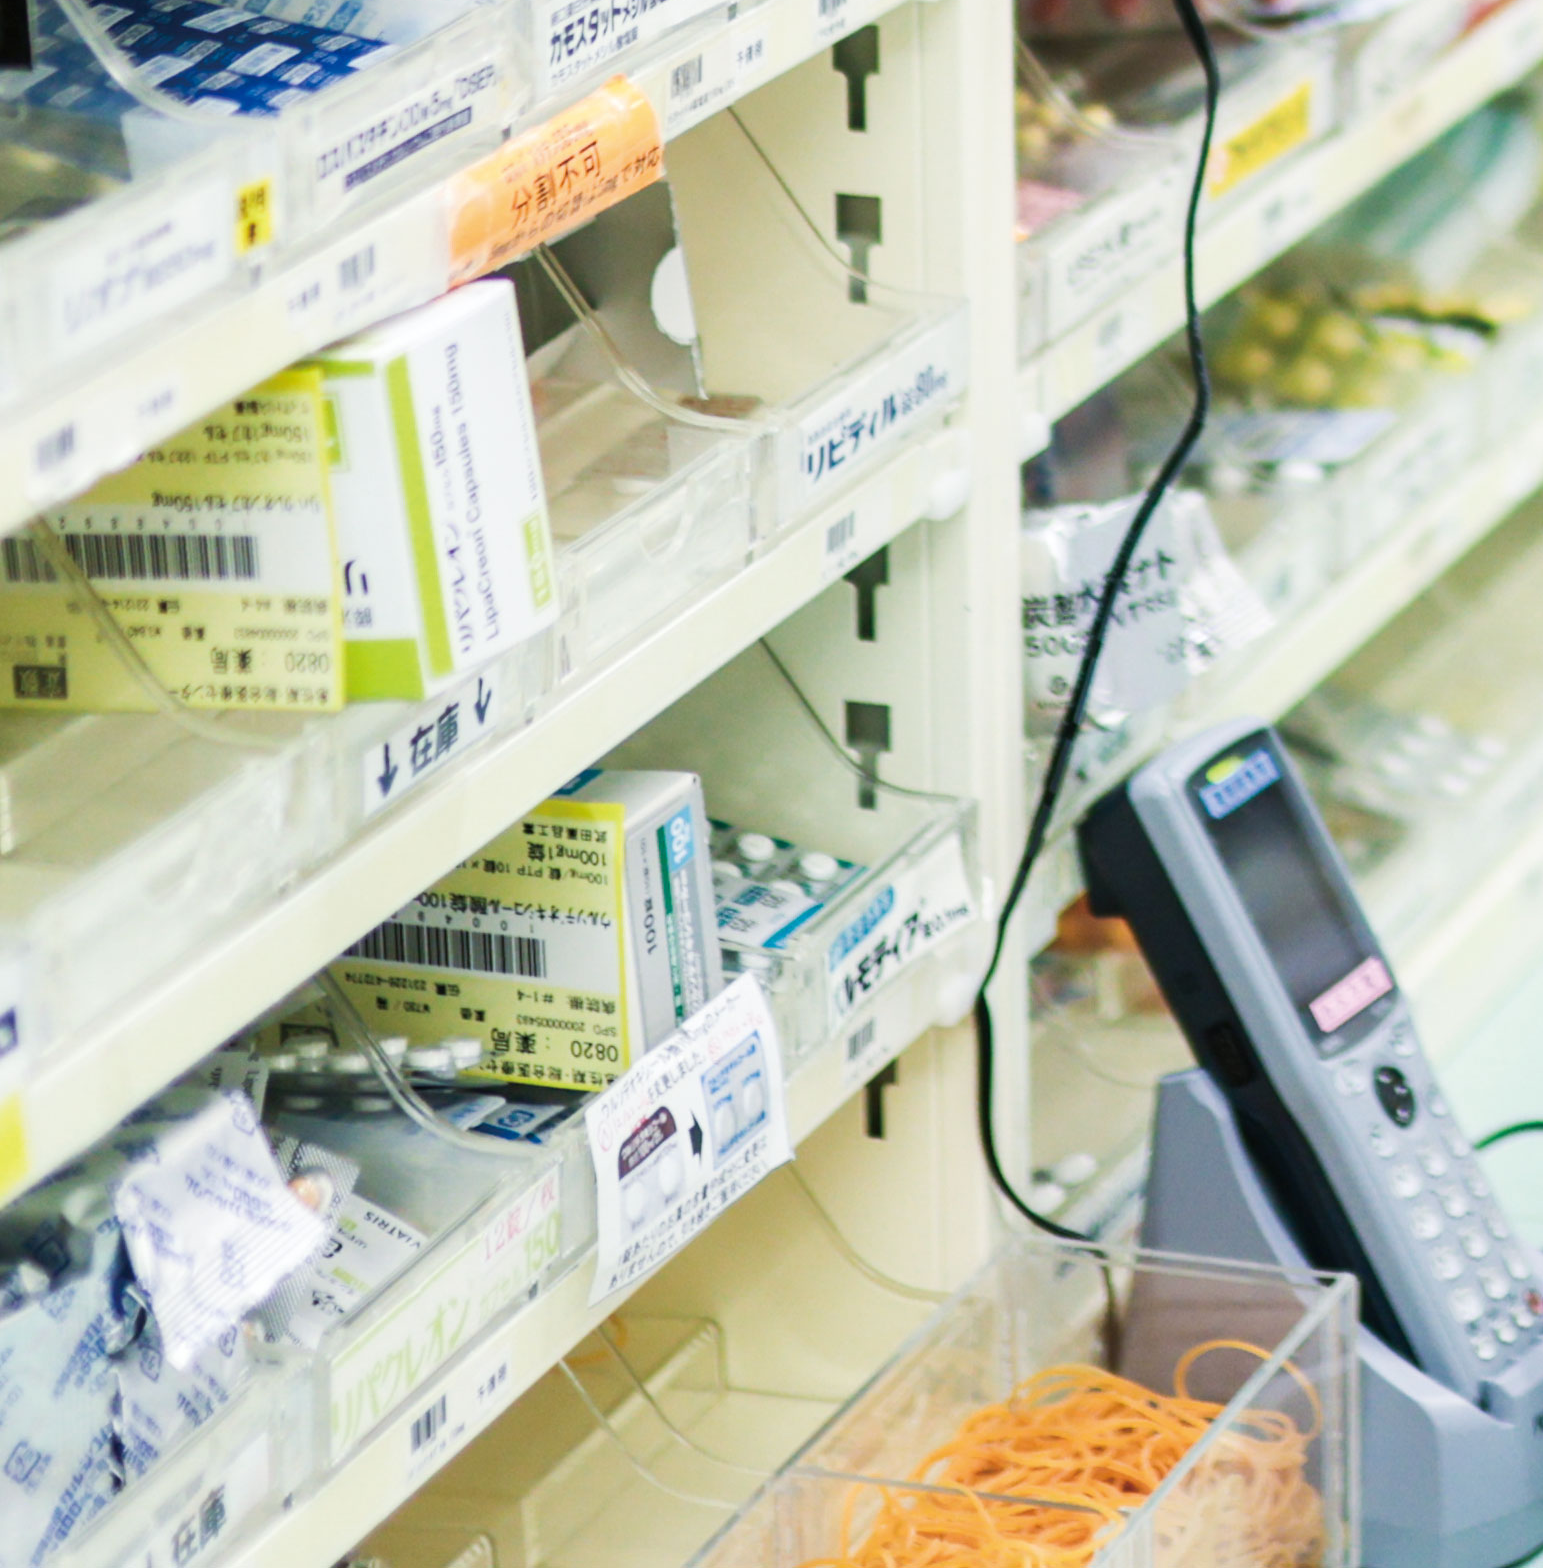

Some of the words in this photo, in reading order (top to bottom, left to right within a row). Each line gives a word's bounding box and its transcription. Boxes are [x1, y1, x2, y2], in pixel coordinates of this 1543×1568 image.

[510, 139, 602, 231] 分割不可
[442, 341, 467, 417] 150mg
[209, 647, 253, 674] 薬局
[284, 651, 330, 675] 0820
[408, 702, 464, 774] 在庫
[521, 820, 608, 844] 武田薬品工業
[525, 841, 609, 868] 100mg1錠
[515, 864, 544, 881] PTP
[490, 1027, 538, 1055] 薬局
[569, 1040, 619, 1064] 0820
[364, 1210, 422, 1251] VIATRIS
